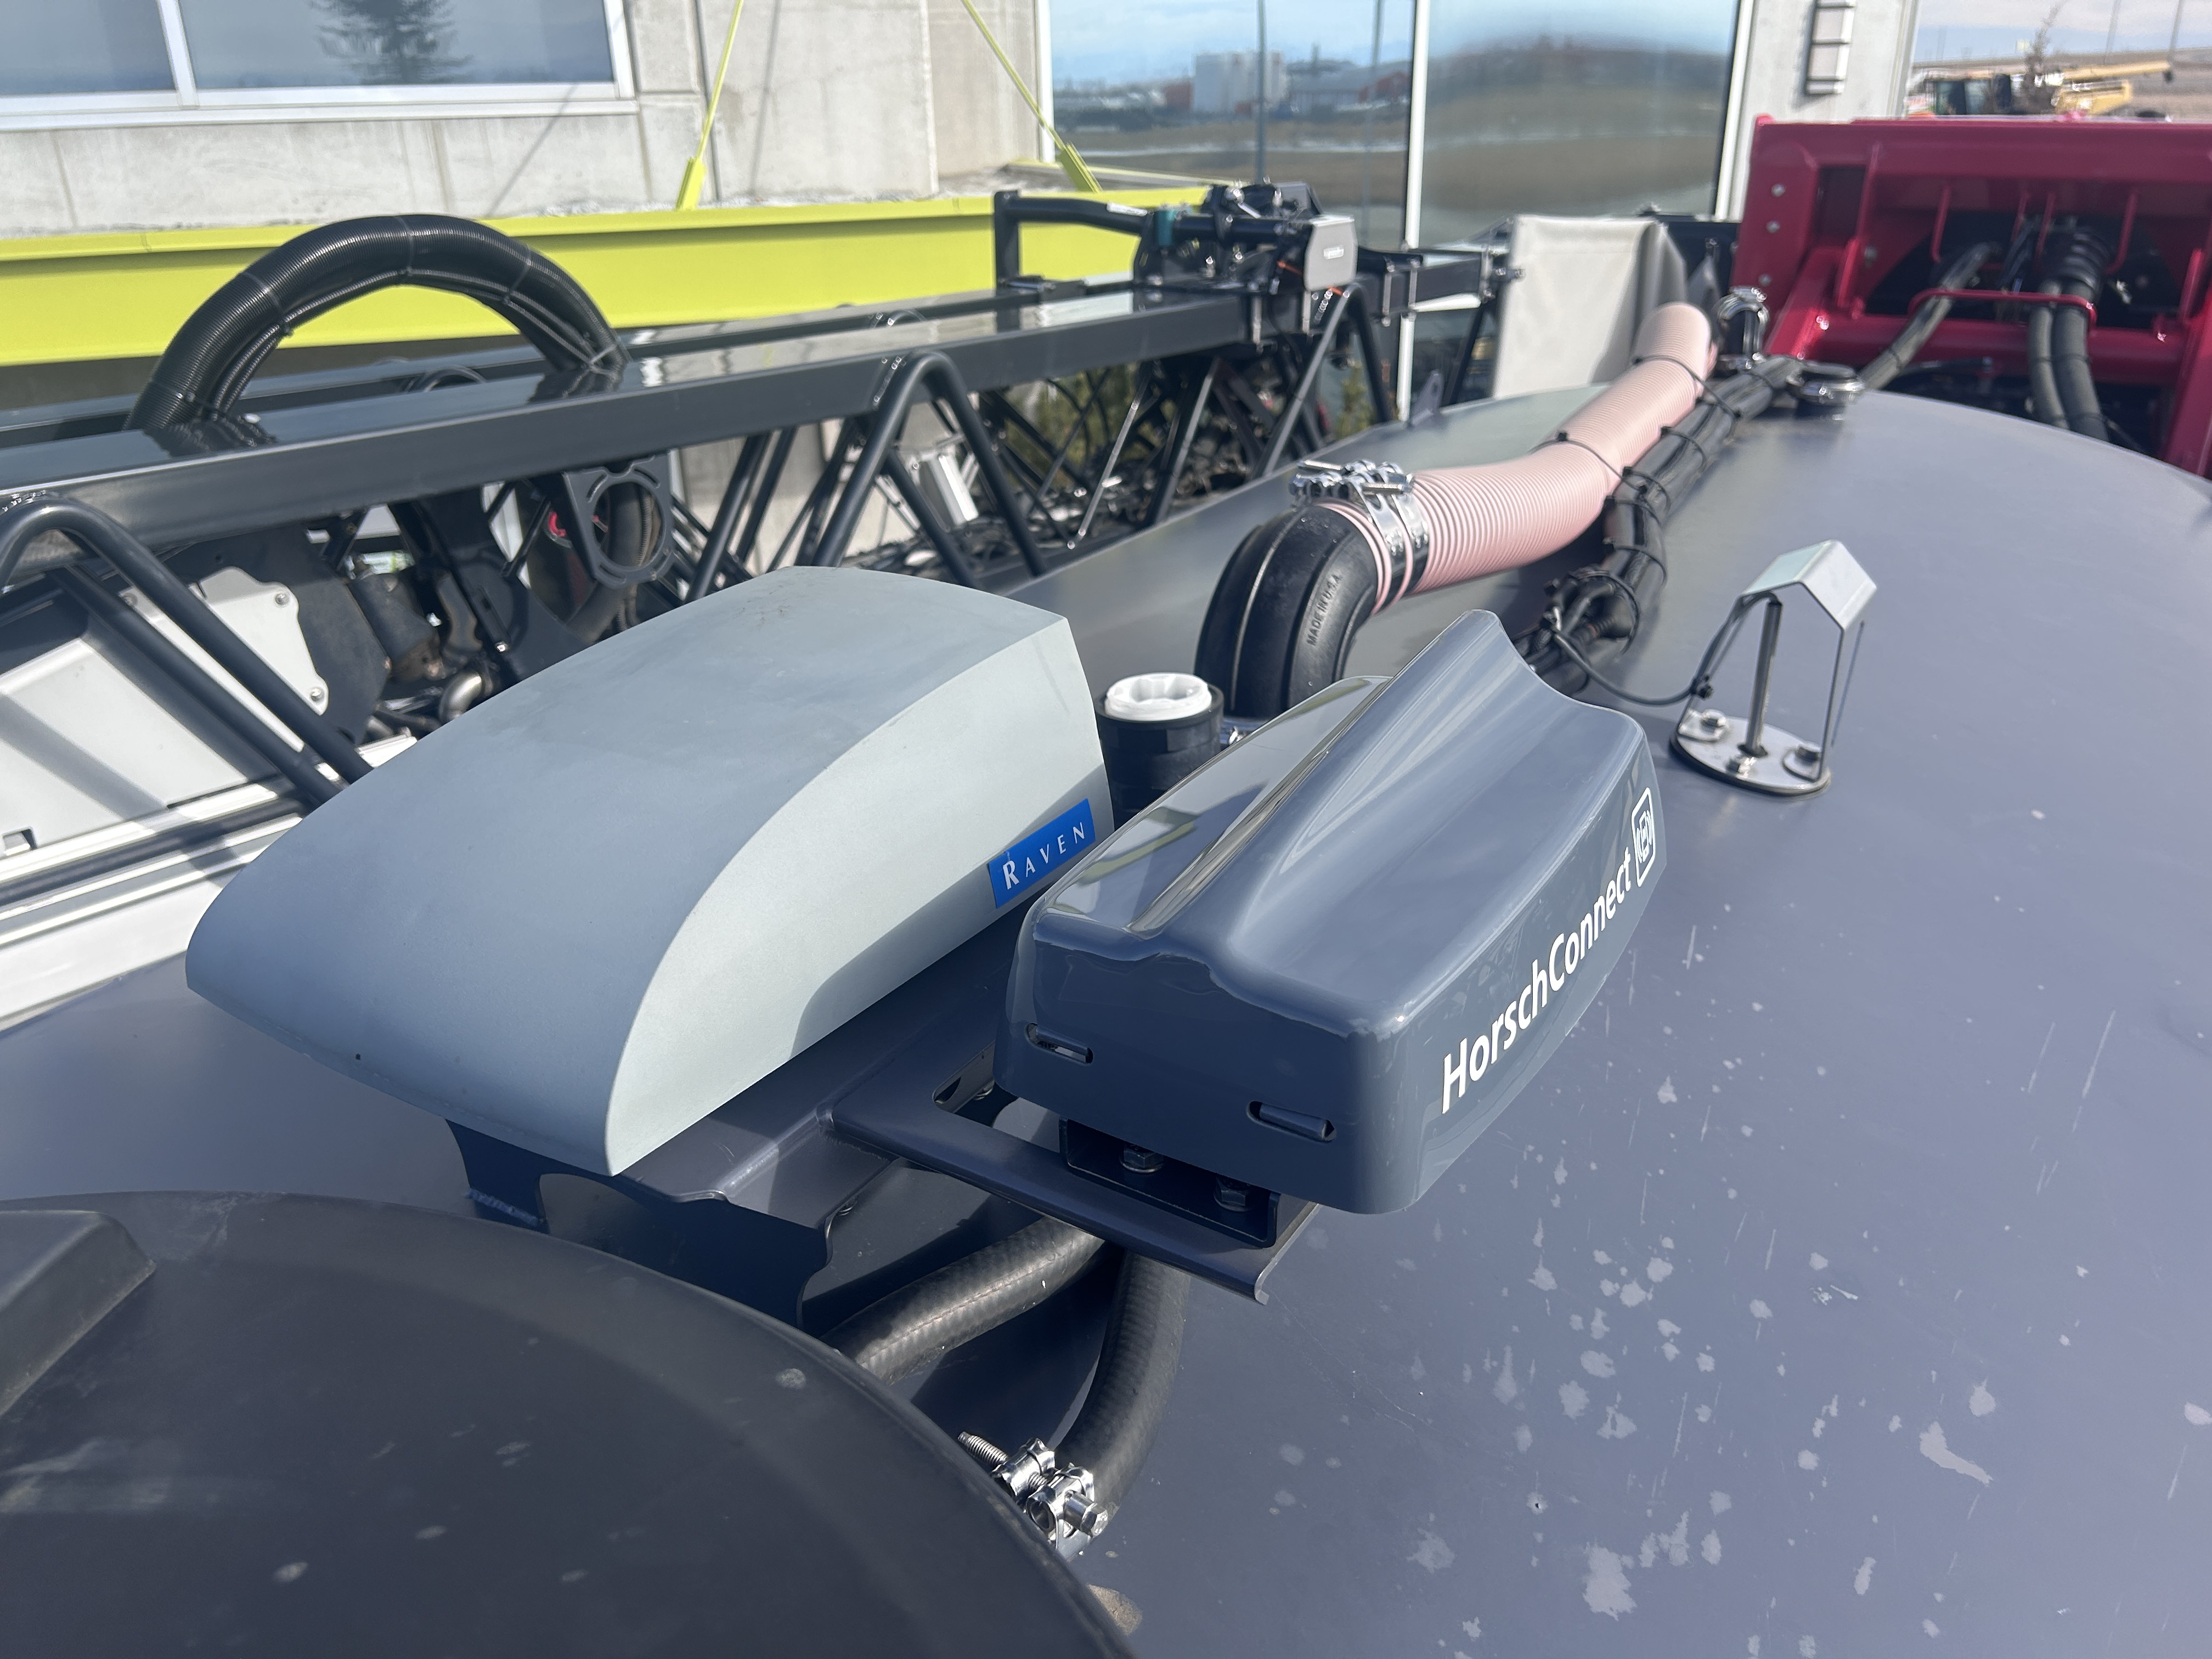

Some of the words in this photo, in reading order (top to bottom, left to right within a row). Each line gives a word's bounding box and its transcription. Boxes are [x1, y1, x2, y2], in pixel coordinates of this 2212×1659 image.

[1306, 611, 1325, 646] MADE
[1316, 599, 1329, 613] IN
[1002, 822, 1085, 890] RAVEN
[1442, 847, 1632, 1114] HorschConnect
